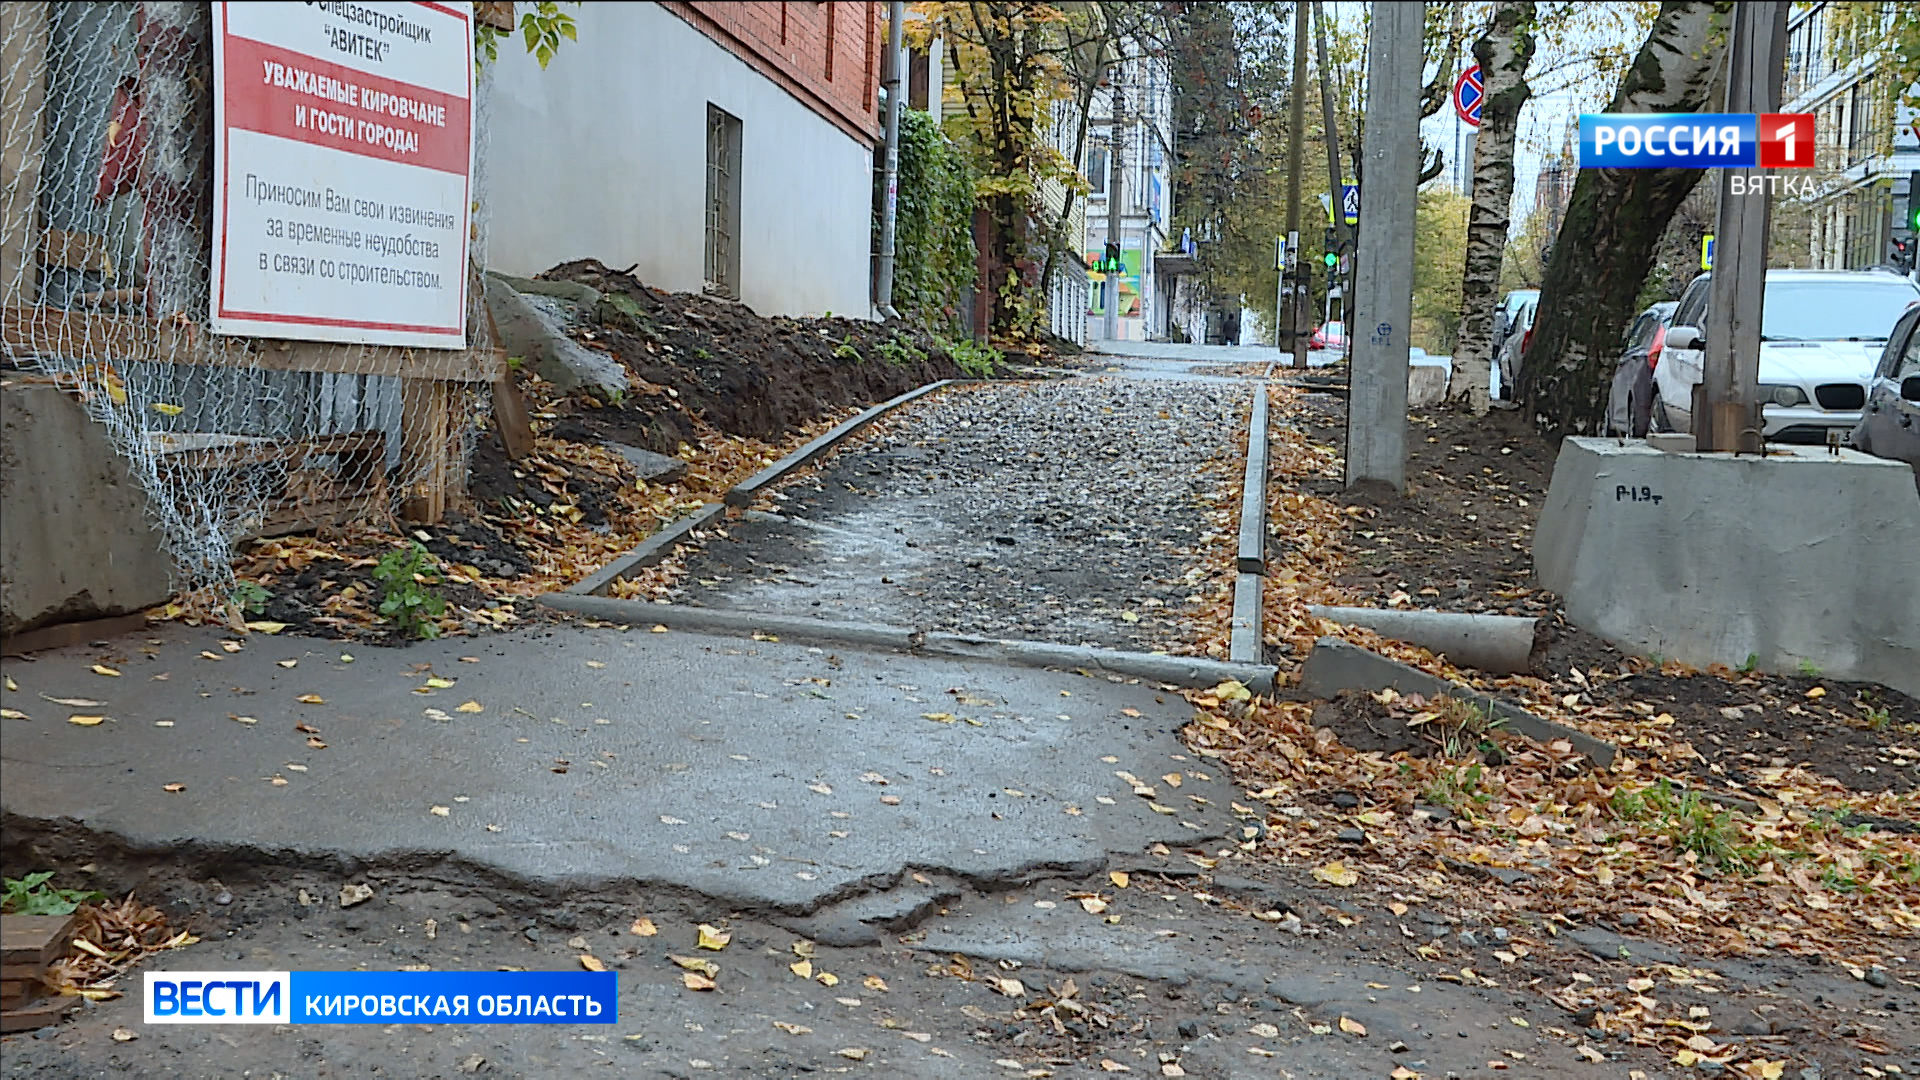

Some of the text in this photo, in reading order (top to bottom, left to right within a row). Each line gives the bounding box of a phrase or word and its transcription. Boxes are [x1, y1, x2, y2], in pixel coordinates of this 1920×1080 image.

[263, 60, 446, 127] УВАЖАЕМЫЕ КИРОВЧАНЕ
[295, 104, 419, 154] И ГОСТИ ГОРОДА!
[245, 173, 455, 230] Приносим Вам свои извинения
[266, 217, 439, 259] за временные неудобства
[259, 252, 443, 290] в связи со строительством.
